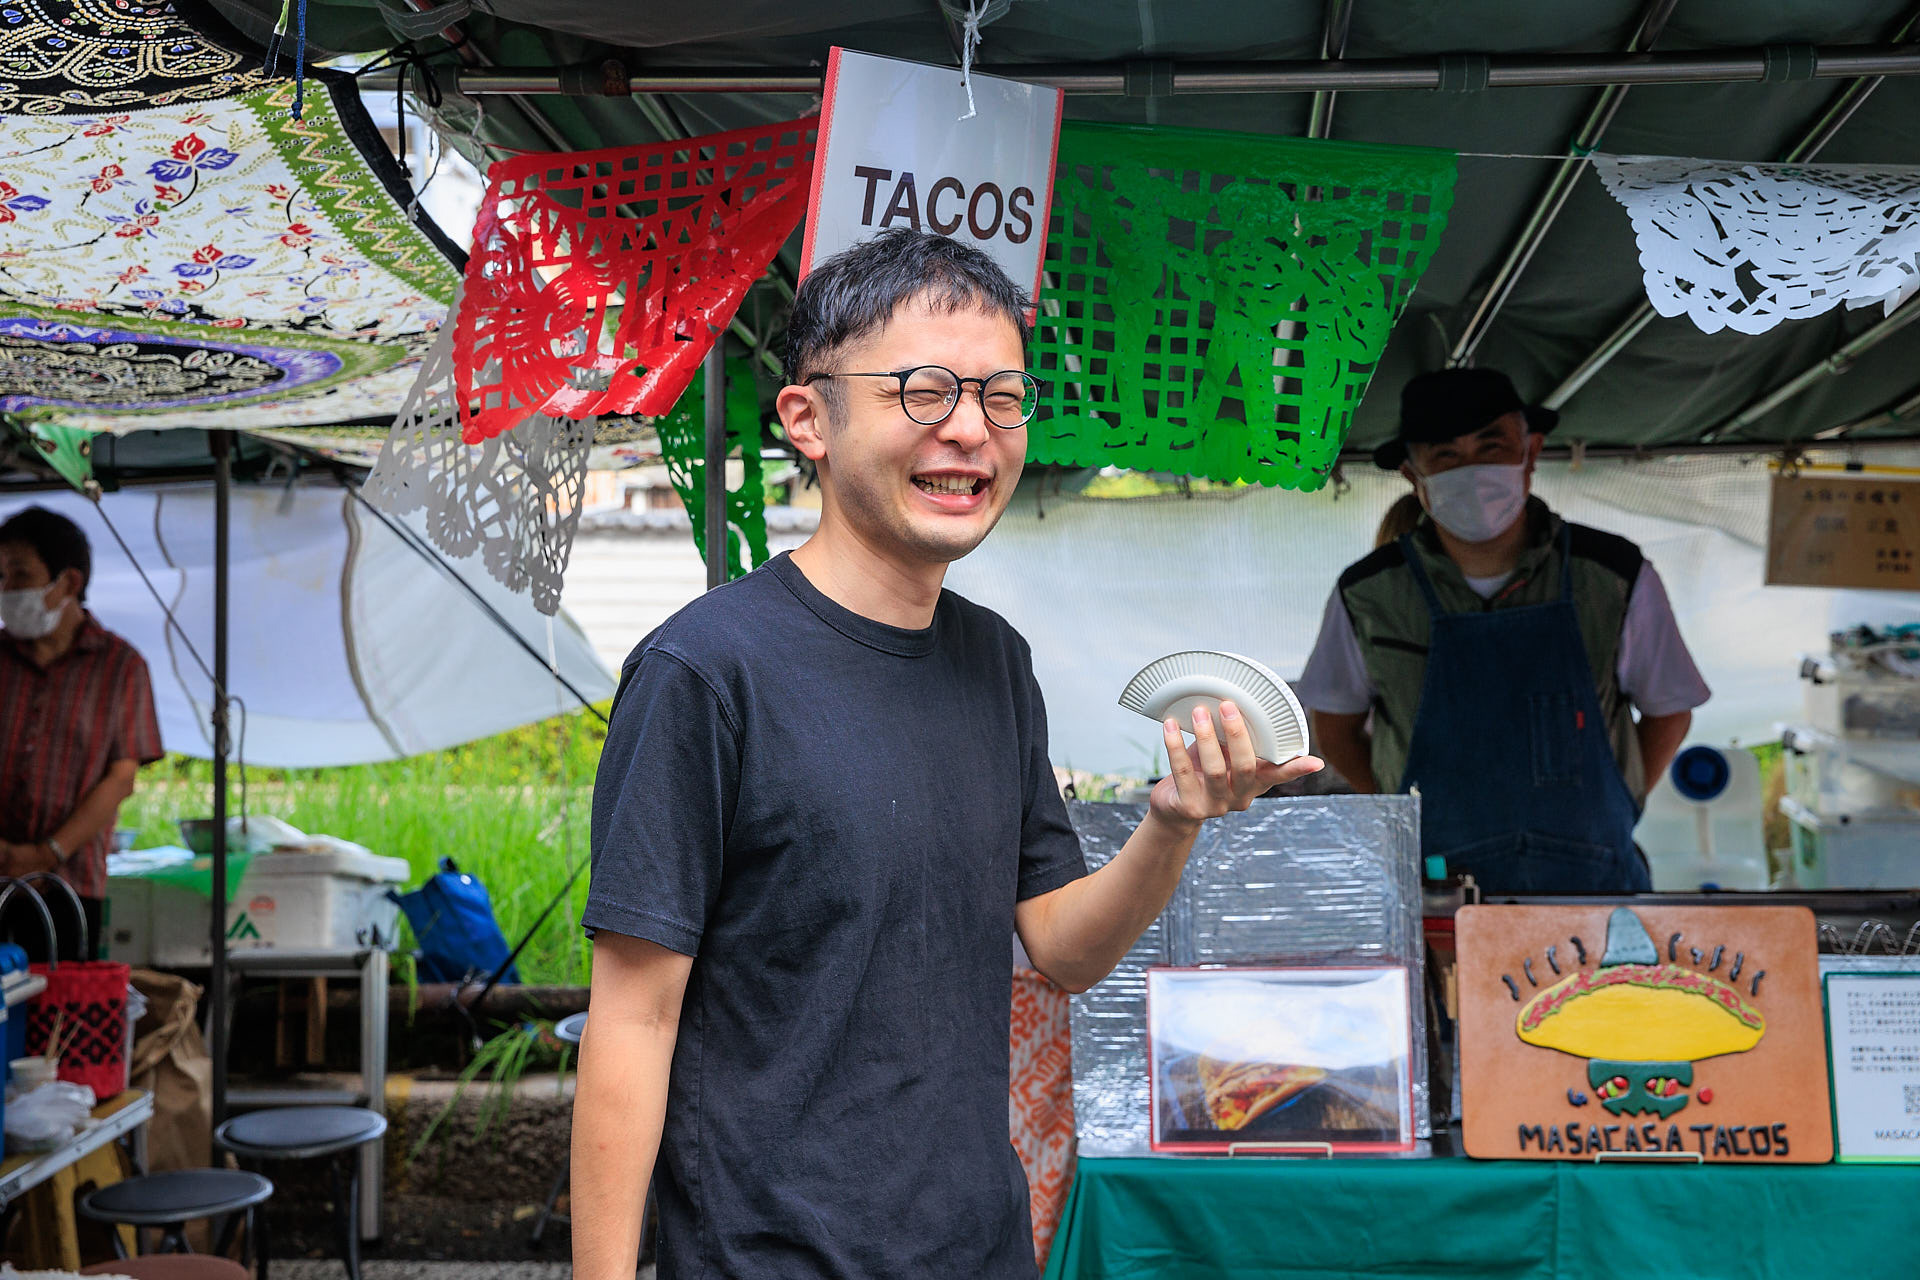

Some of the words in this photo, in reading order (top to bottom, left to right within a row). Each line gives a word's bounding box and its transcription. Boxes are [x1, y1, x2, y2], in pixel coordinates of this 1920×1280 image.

[854, 165, 1035, 244] TACOS
[1518, 1123, 1684, 1153] MASACASA
[1690, 1123, 1790, 1156] TACOS
